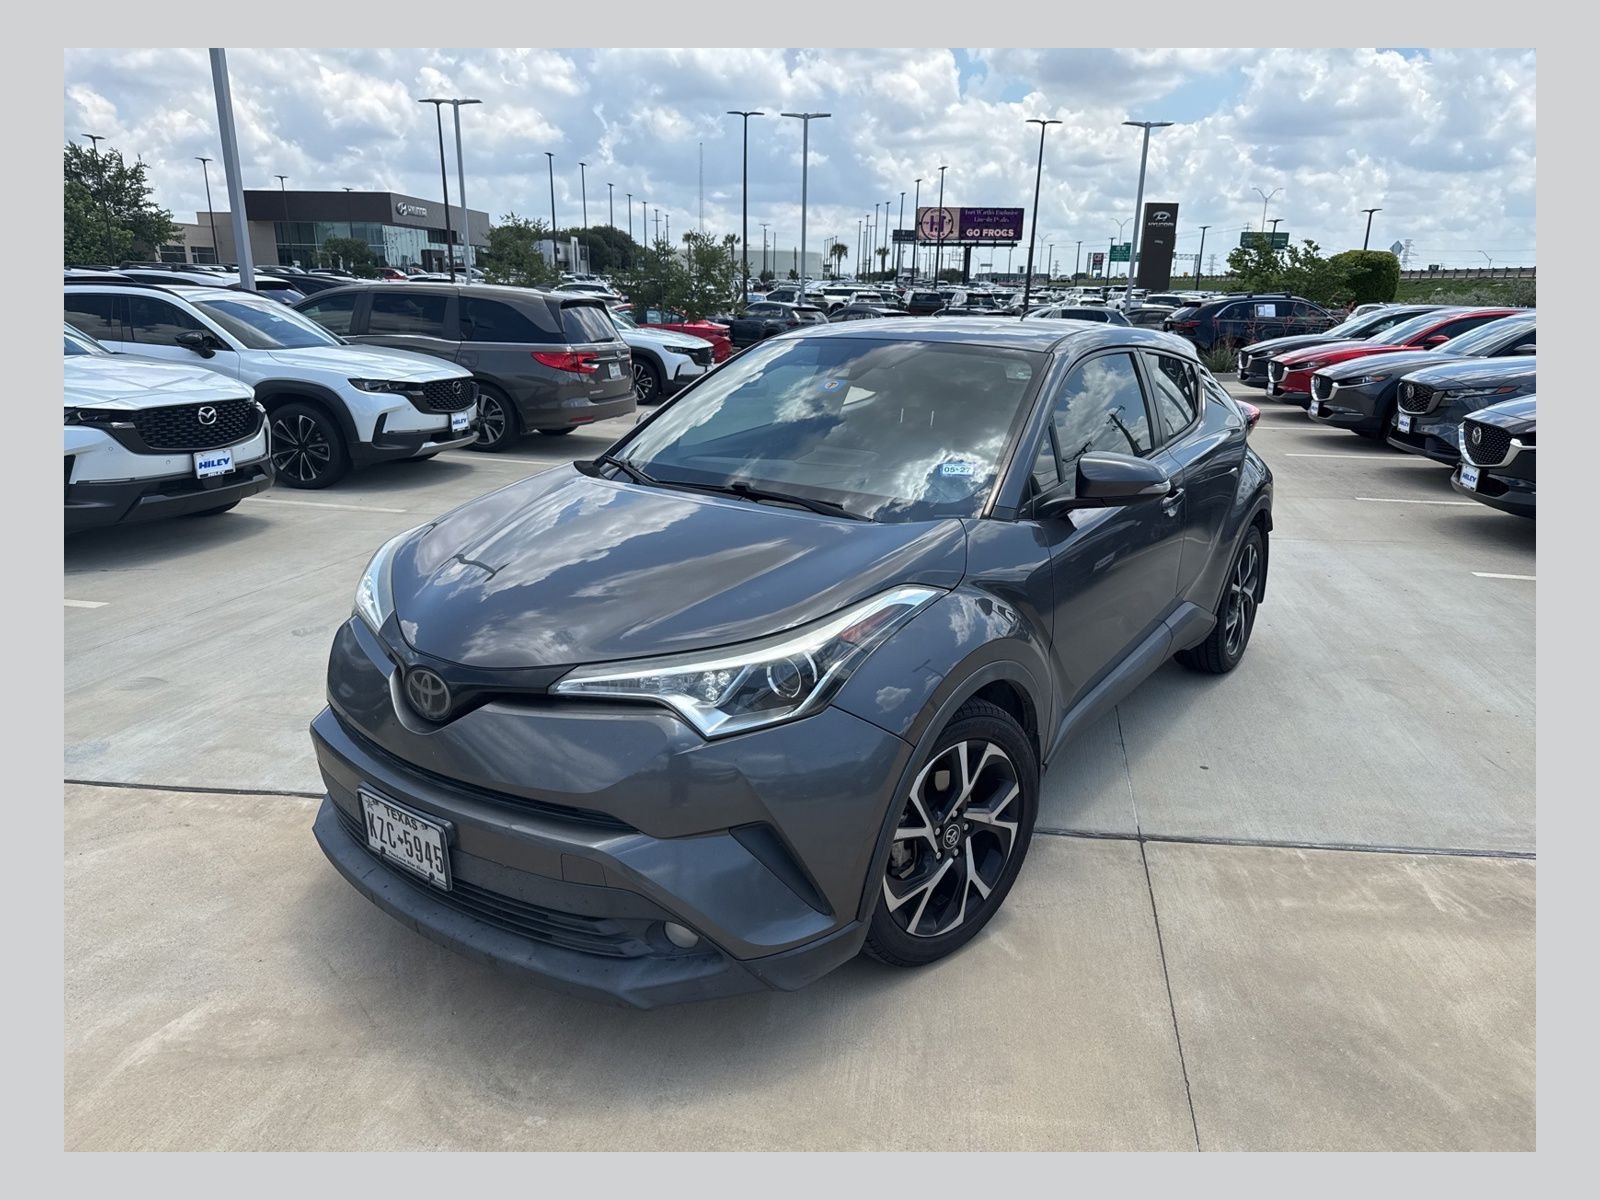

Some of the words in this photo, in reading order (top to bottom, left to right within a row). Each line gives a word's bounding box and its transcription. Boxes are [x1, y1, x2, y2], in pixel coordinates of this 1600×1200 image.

[966, 228, 981, 237] GO
[982, 228, 1014, 237] FROGS
[198, 457, 231, 470] HILEY
[384, 805, 419, 831] TEXAS
